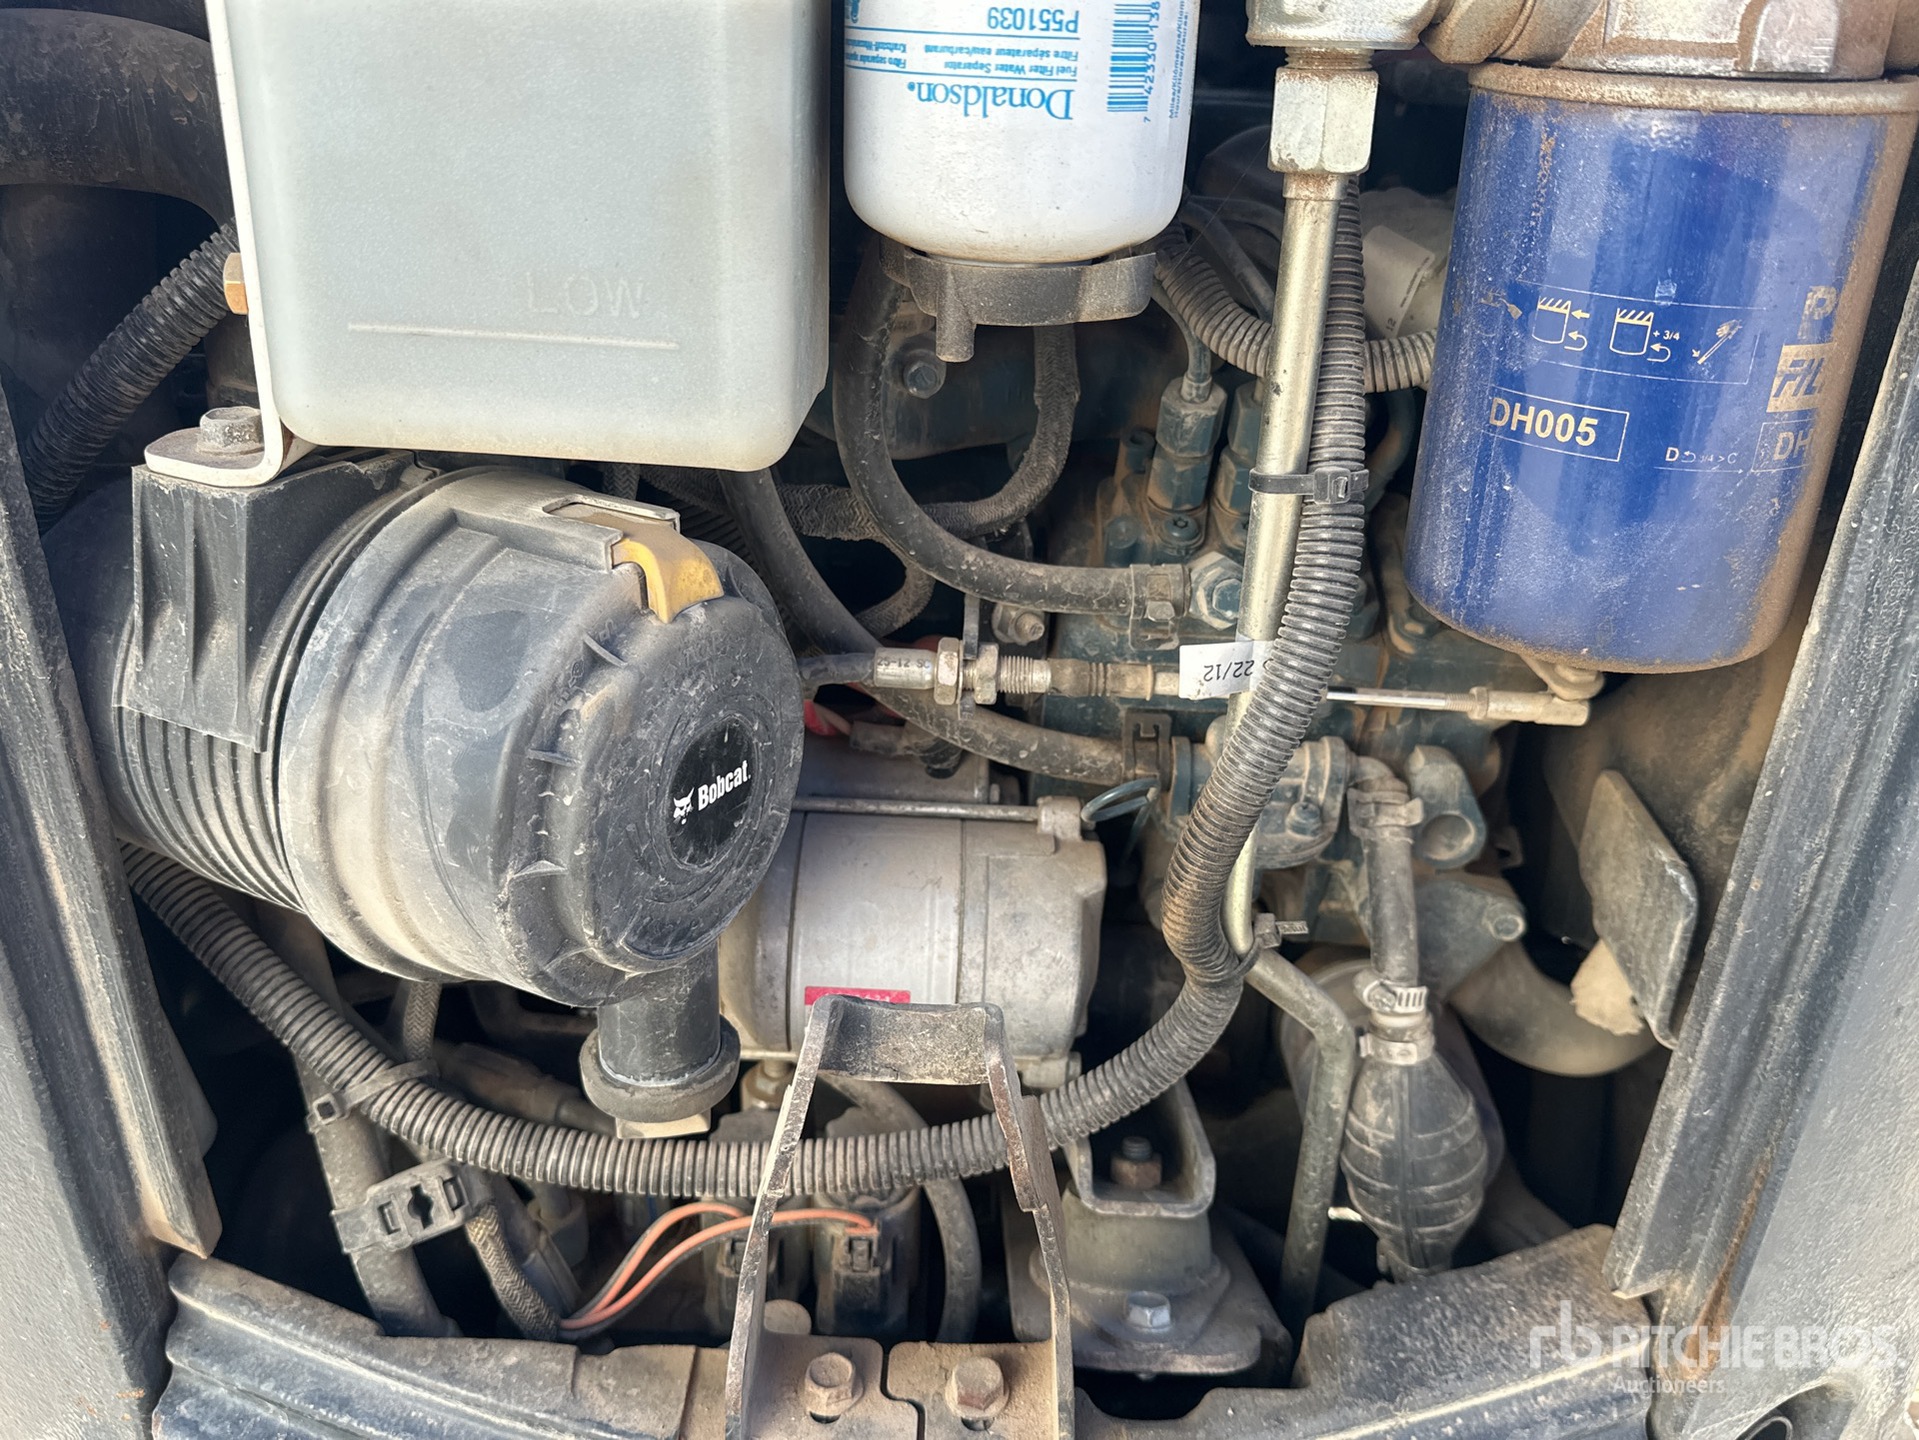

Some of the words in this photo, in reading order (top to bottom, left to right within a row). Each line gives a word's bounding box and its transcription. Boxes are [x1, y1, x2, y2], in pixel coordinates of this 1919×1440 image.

[987, 6, 1080, 34] P551039
[1053, 50, 1079, 62] Filtre
[944, 61, 991, 74] Separator
[995, 63, 1026, 76] Water
[1029, 65, 1054, 77] Filter
[1056, 66, 1078, 77] Fuel
[526, 271, 645, 319] LOW
[1662, 330, 1681, 341] 3/4
[1489, 397, 1599, 447] DH005
[1665, 446, 1680, 463] D
[1203, 660, 1255, 681] 22/12
